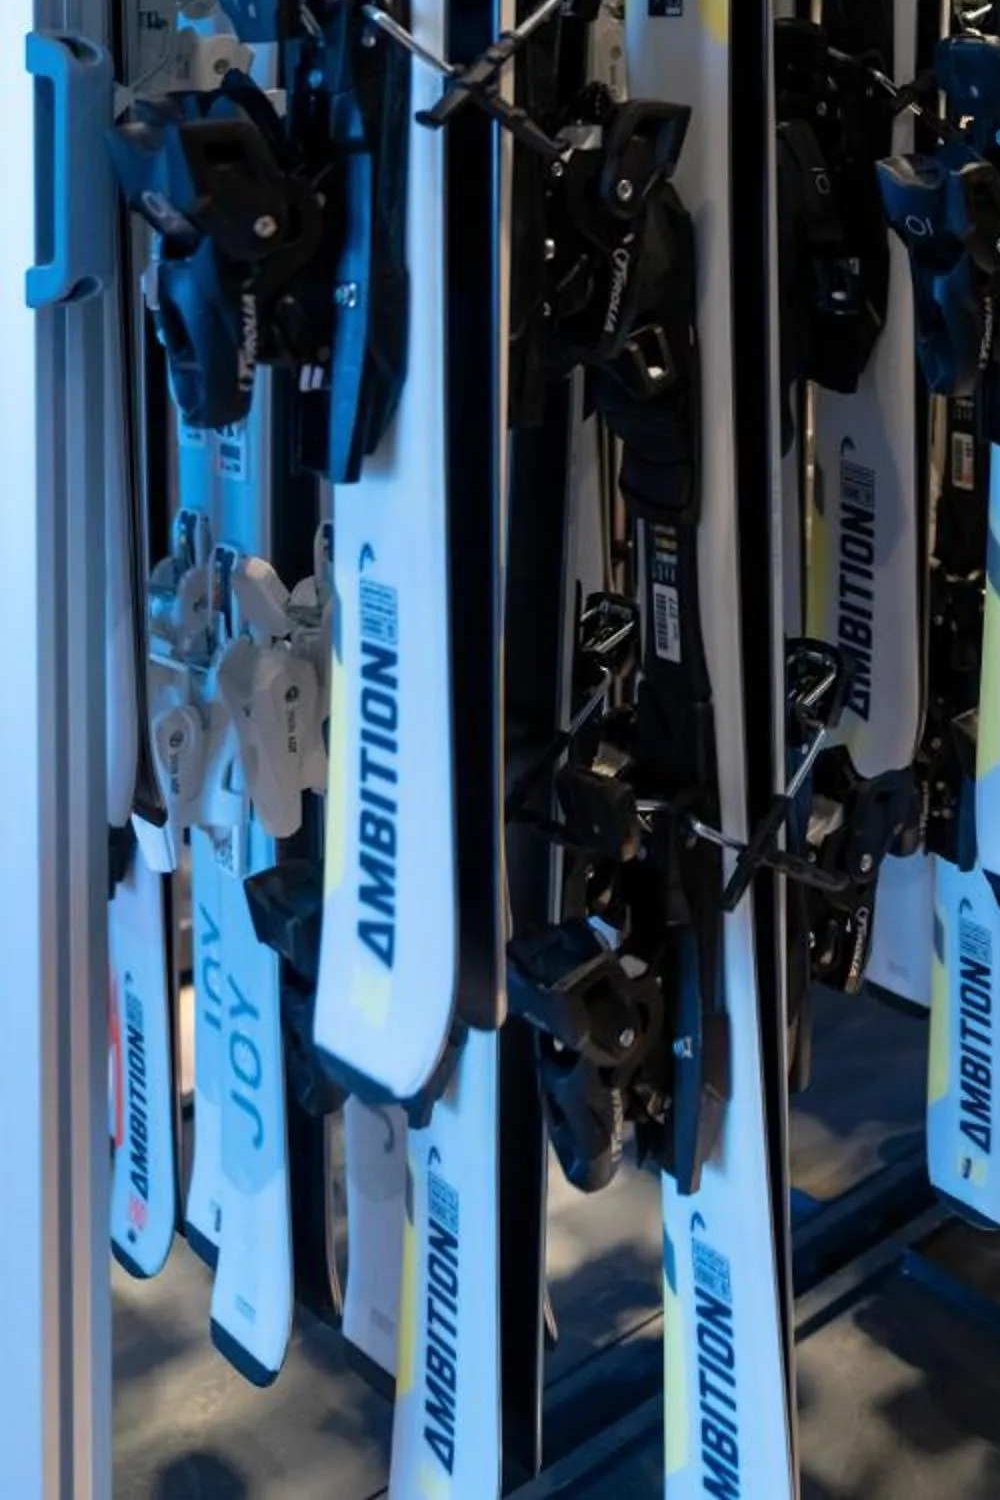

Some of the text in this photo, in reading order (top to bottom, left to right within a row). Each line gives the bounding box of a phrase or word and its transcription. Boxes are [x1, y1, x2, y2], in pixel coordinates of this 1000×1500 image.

[357, 642, 401, 970] AMBITION
[126, 1024, 149, 1202] AMBITION
[227, 973, 263, 1153] JOY
[959, 952, 993, 1156] AMBITION
[424, 1219, 459, 1476] AMBITION
[696, 1286, 742, 1500] MBITION
